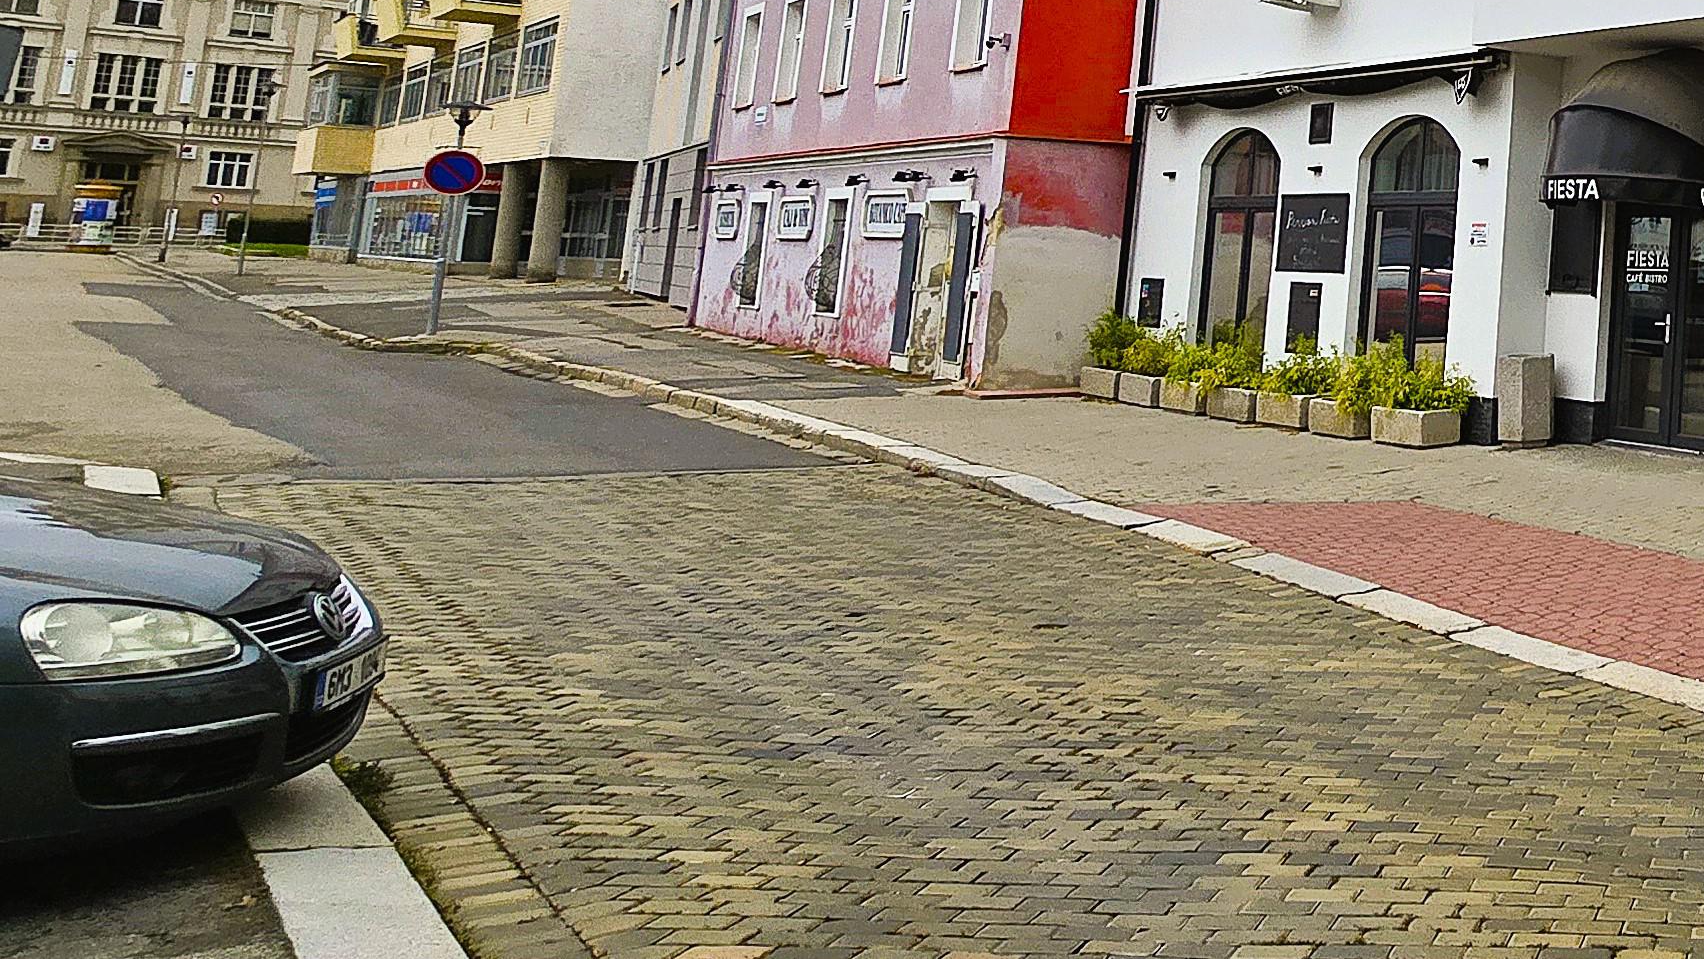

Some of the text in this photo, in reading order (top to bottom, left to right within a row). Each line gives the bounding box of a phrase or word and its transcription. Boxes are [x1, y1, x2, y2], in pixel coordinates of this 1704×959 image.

[1547, 178, 1600, 200] FIESTA
[1626, 249, 1669, 268] FIESTA
[1626, 272, 1667, 283] CAFÉ BISTRO
